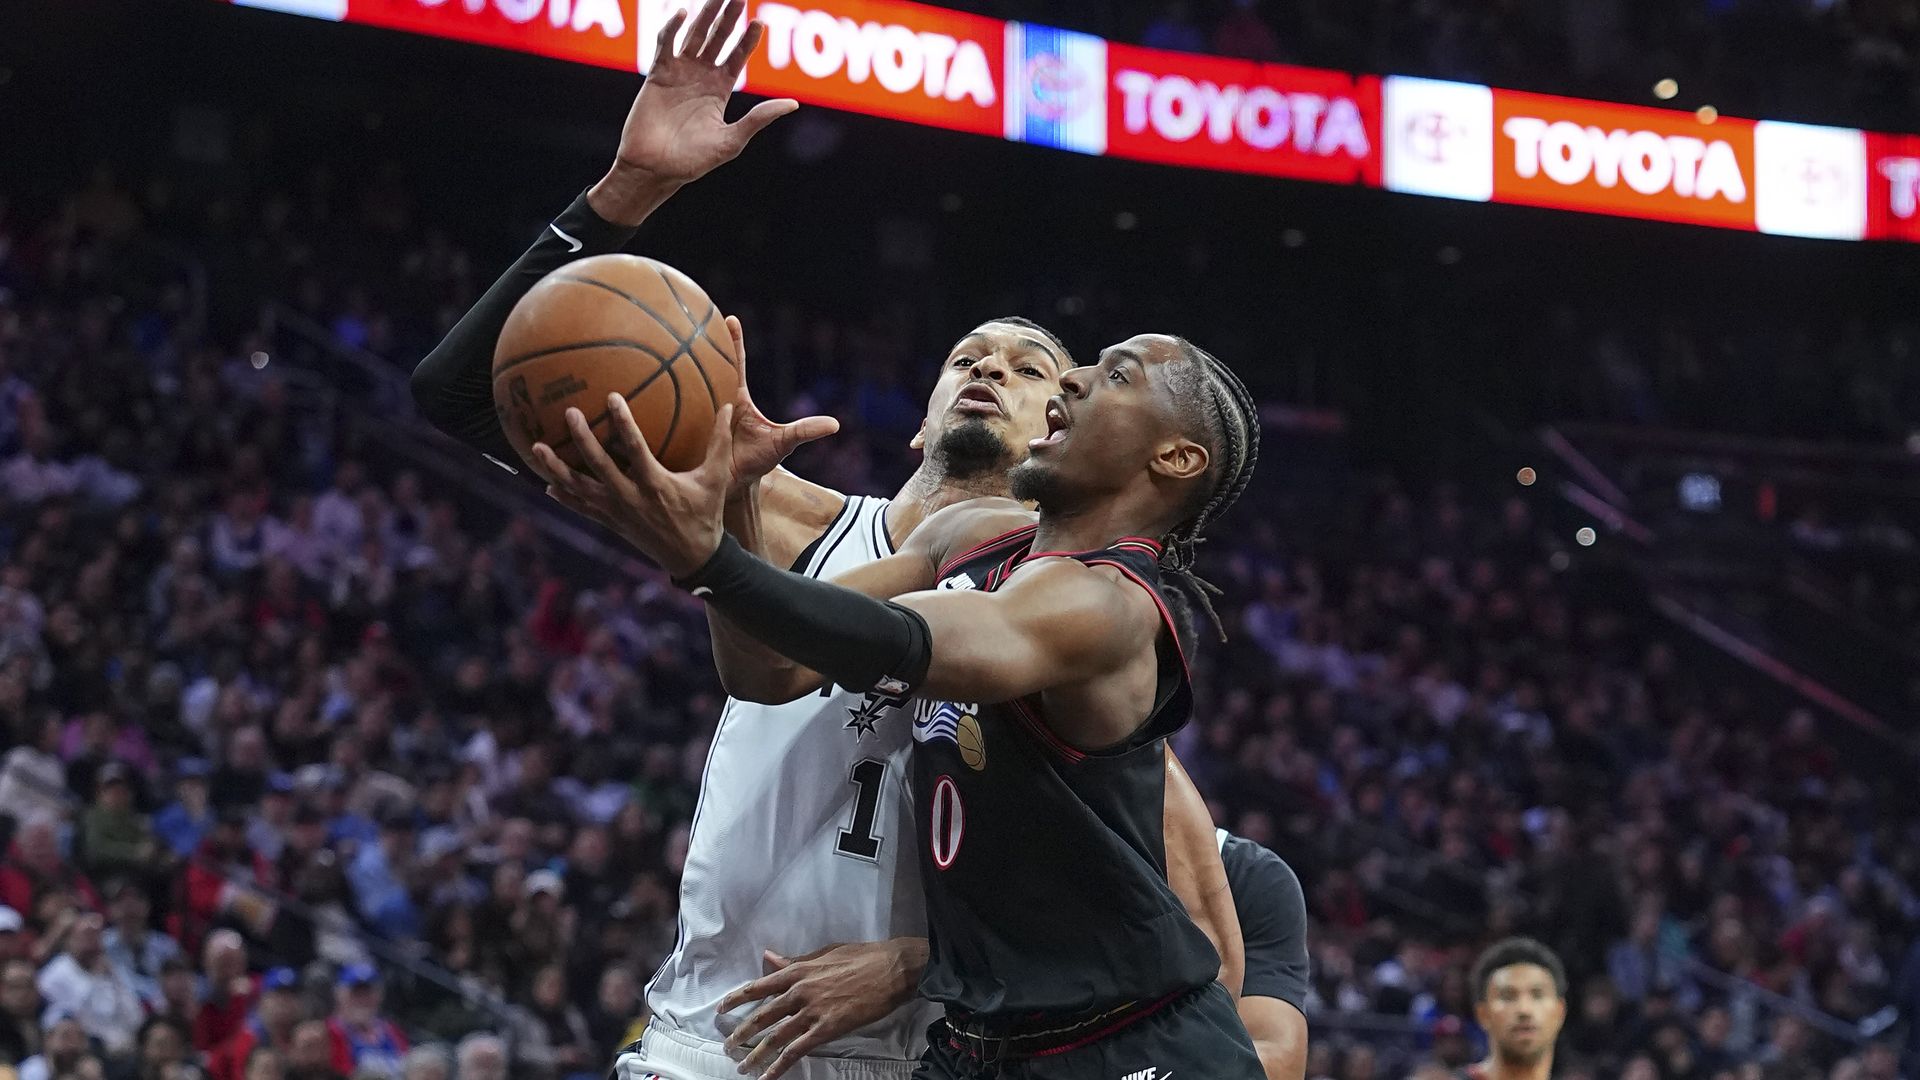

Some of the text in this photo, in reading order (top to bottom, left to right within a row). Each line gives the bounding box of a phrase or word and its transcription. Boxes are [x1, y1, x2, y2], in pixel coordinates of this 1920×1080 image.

[756, 2, 995, 108] TOYOTA
[1114, 69, 1371, 159] TOYOTA
[1503, 117, 1746, 203] TOYOTA
[1877, 157, 1920, 218] T
[833, 758, 890, 864] 1
[931, 774, 965, 871] 0
